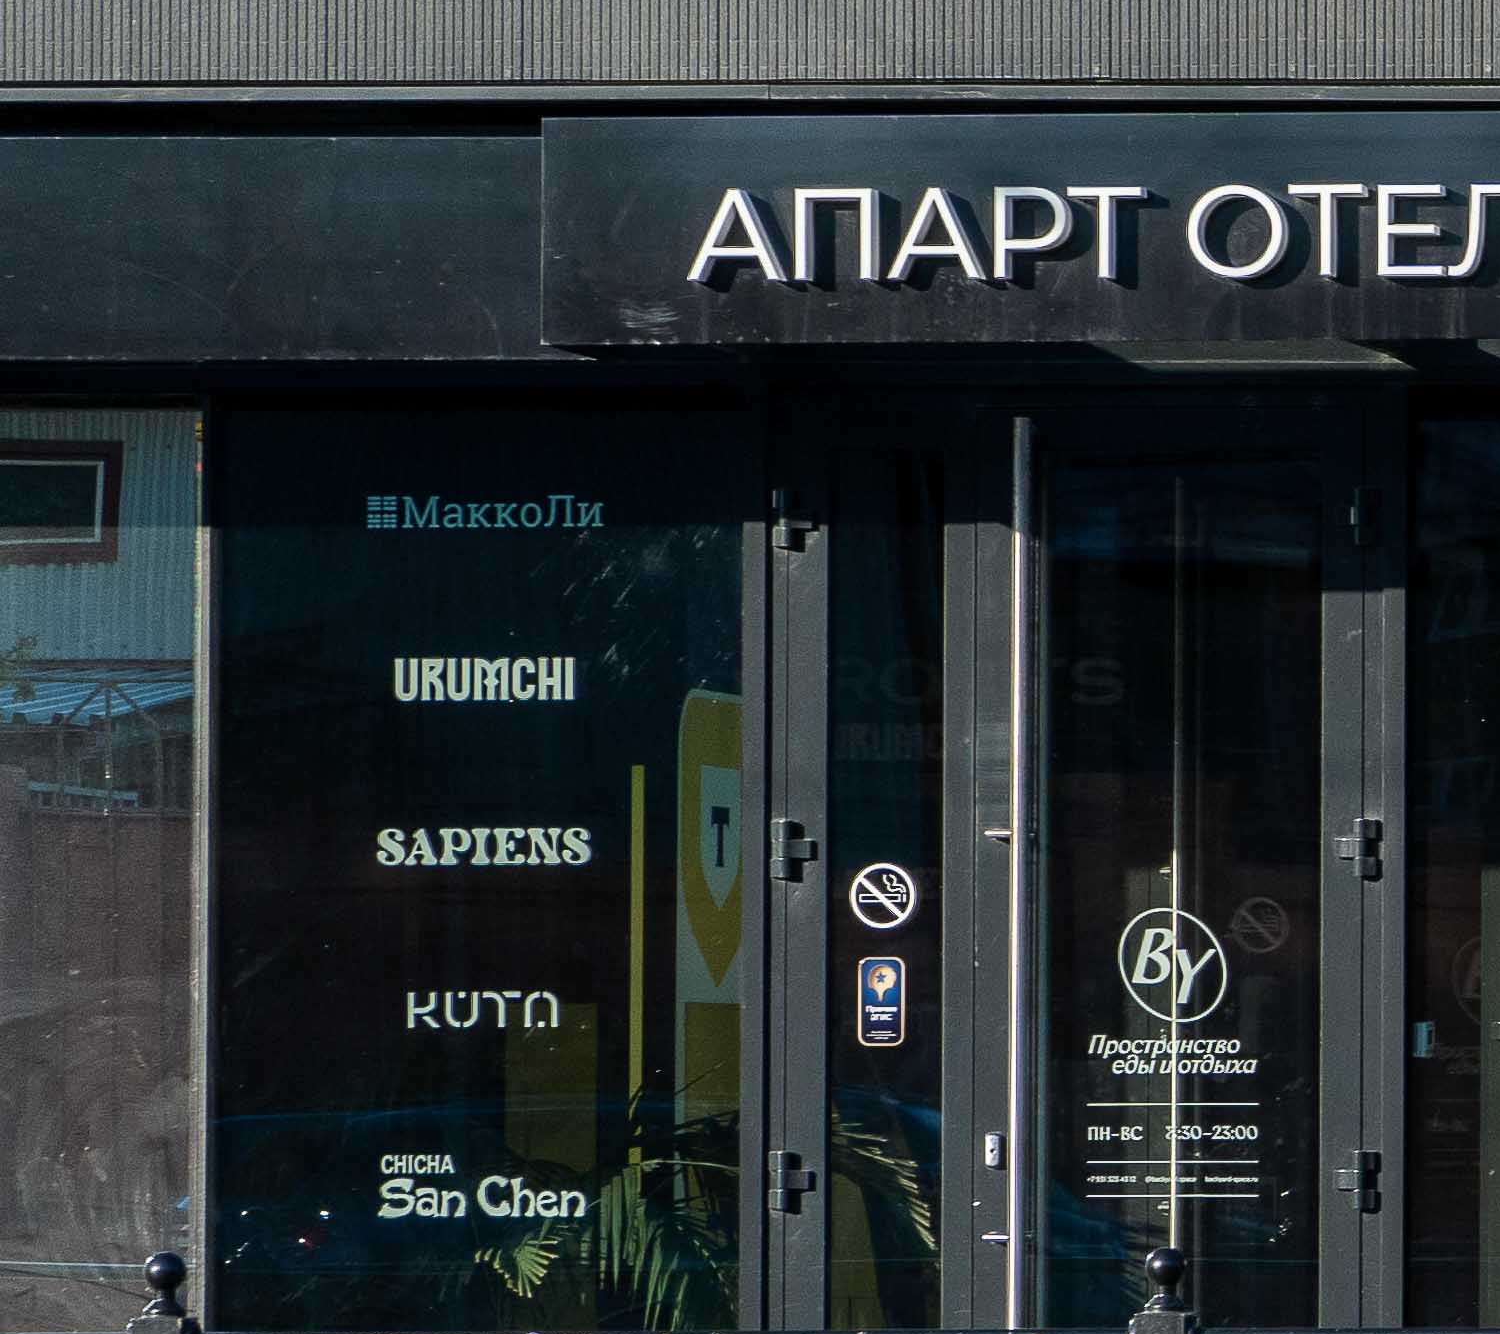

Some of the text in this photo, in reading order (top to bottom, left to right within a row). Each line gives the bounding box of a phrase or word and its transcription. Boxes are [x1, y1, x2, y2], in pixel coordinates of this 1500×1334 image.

[686, 186, 1148, 282] АПАРТ
[401, 494, 605, 530] МаккоЛи
[394, 656, 577, 702] URUMCHI
[376, 827, 592, 866] SAPIENS
[1087, 1034, 1241, 1059] Пространство
[1111, 1053, 1156, 1075] еды
[1177, 1053, 1259, 1075] отдыха
[380, 1154, 456, 1175] CHICHA
[377, 1175, 587, 1219] San Chen
